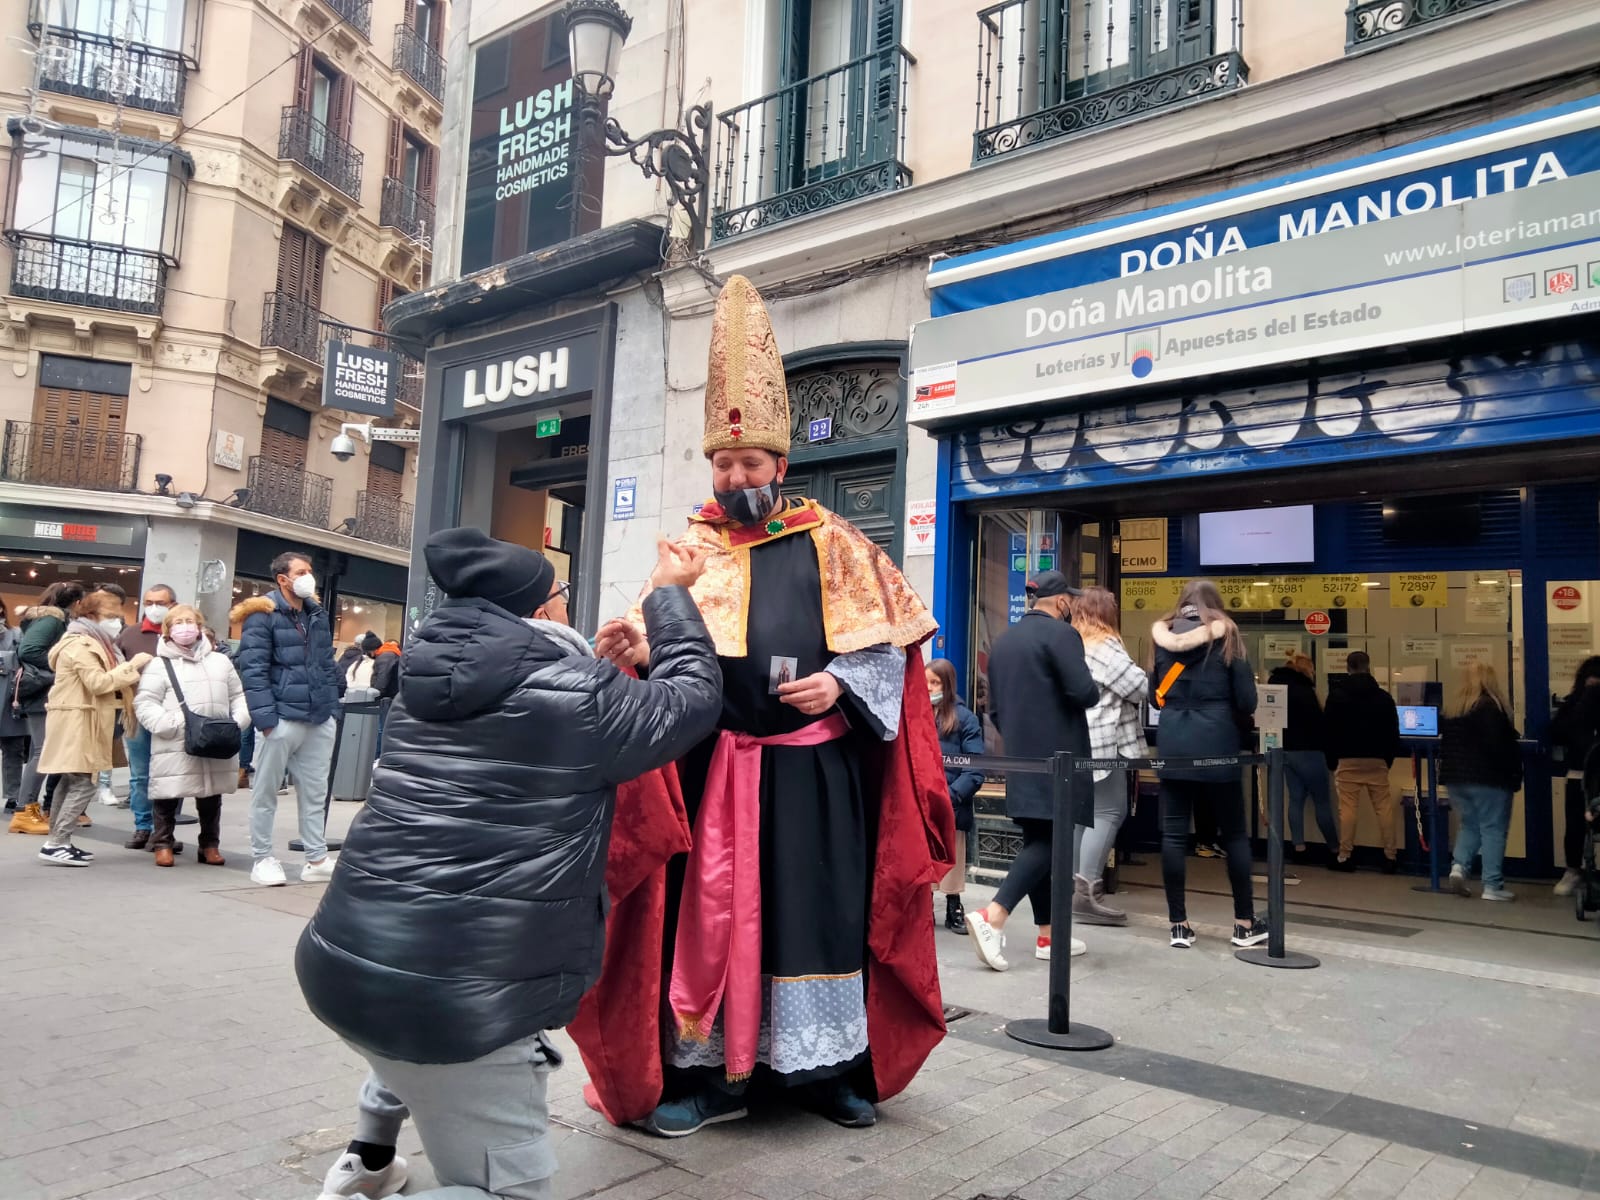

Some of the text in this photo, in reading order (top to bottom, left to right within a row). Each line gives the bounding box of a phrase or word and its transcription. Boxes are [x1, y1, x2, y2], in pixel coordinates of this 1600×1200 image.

[500, 78, 573, 136] LUSH
[498, 112, 571, 165] FRESH
[496, 142, 569, 183] HANDMADE
[495, 161, 568, 200] COSMETICS
[1120, 151, 1568, 278] DOÑA MANOLITA
[1026, 265, 1272, 338] Doña Manolita
[1035, 302, 1383, 378] Loterías y Apuestas del Estado
[336, 352, 388, 376] LUSH
[335, 366, 387, 388] FRESH
[335, 379, 386, 397] HANDMADE
[463, 347, 569, 408] LUSH
[334, 388, 386, 404] COSMETICS
[34, 522, 62, 537] MEGA
[1125, 586, 1156, 596] 86986
[1271, 584, 1303, 593] 75981
[1400, 581, 1436, 592] 72897
[1557, 588, 1574, 597] +18
[1311, 614, 1324, 622] +18
